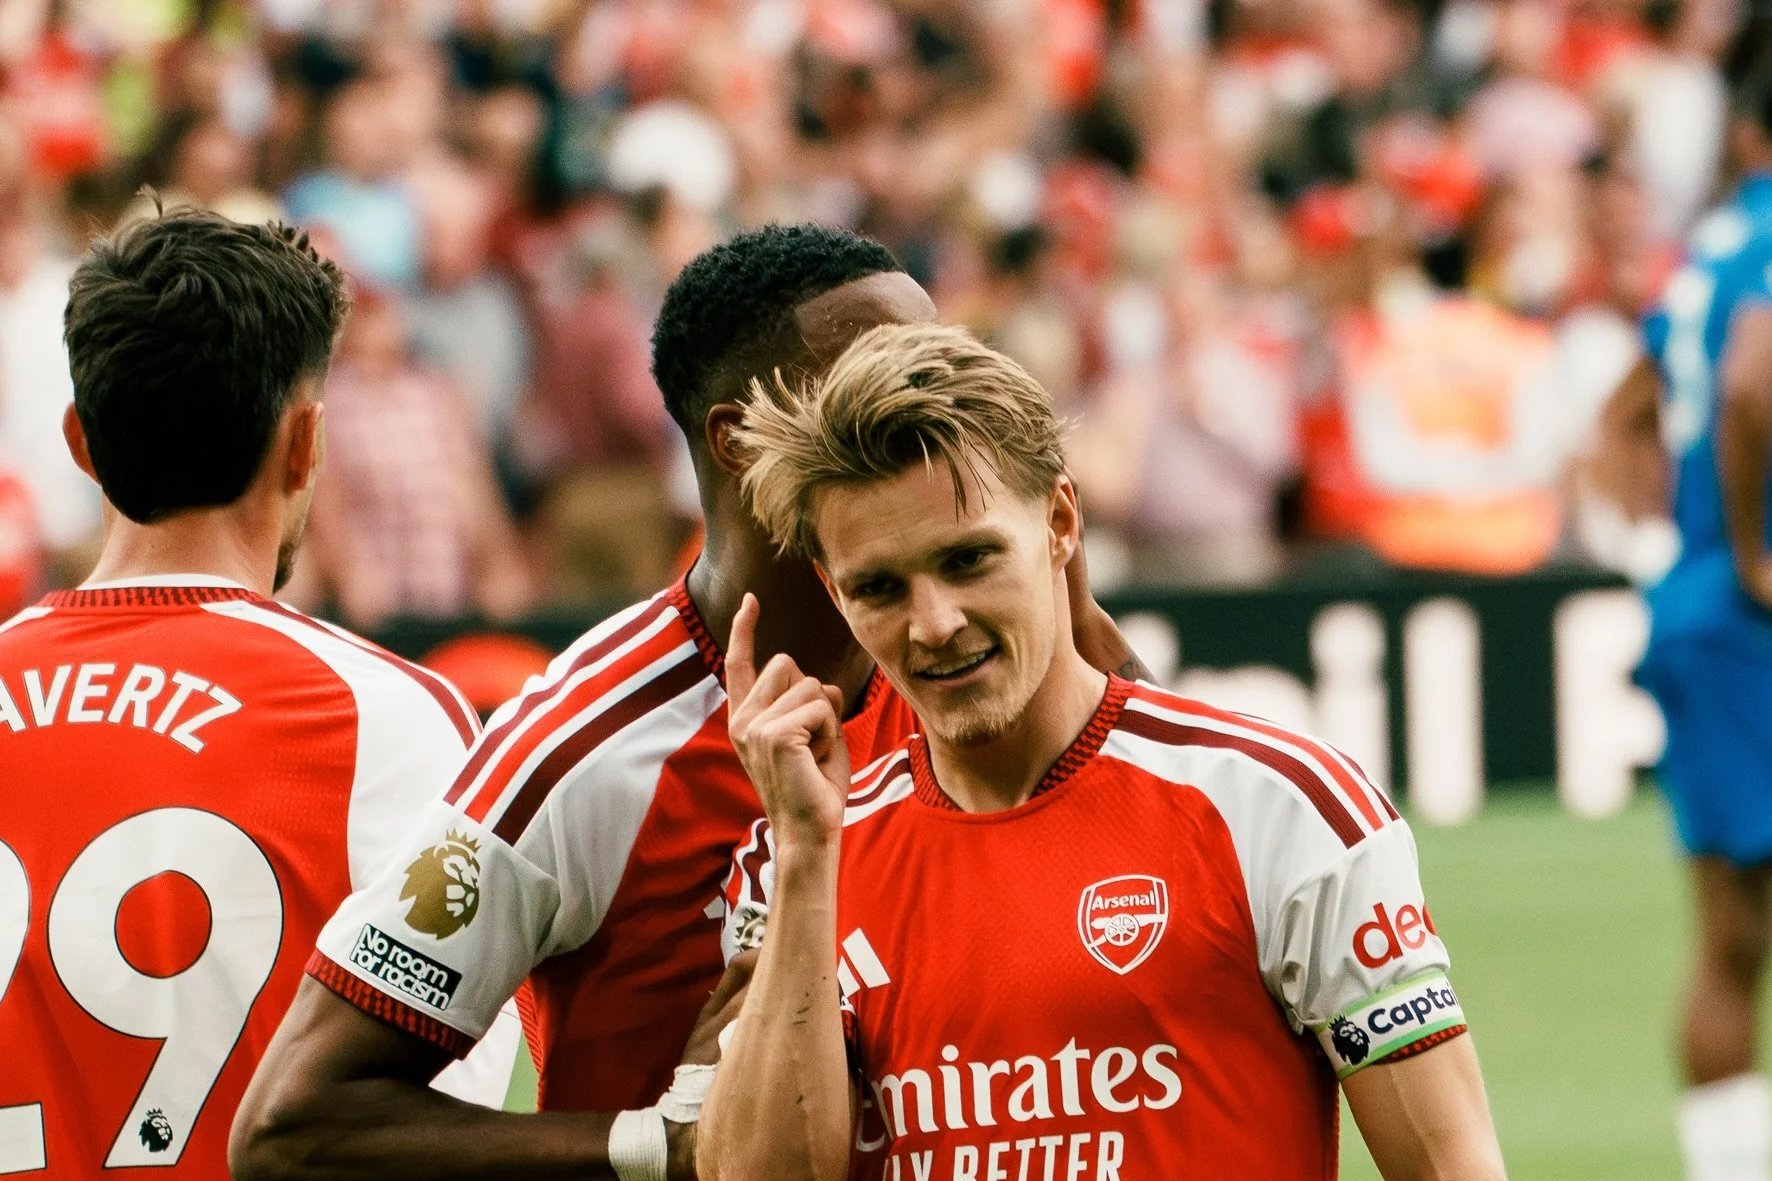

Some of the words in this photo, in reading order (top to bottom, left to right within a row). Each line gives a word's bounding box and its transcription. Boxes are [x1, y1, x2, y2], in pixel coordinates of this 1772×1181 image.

[1091, 890, 1155, 911] Arsenal
[351, 941, 382, 972] for
[379, 961, 450, 1010] racism
[360, 924, 388, 955] No
[388, 945, 448, 988] room
[0, 806, 284, 1174] 9
